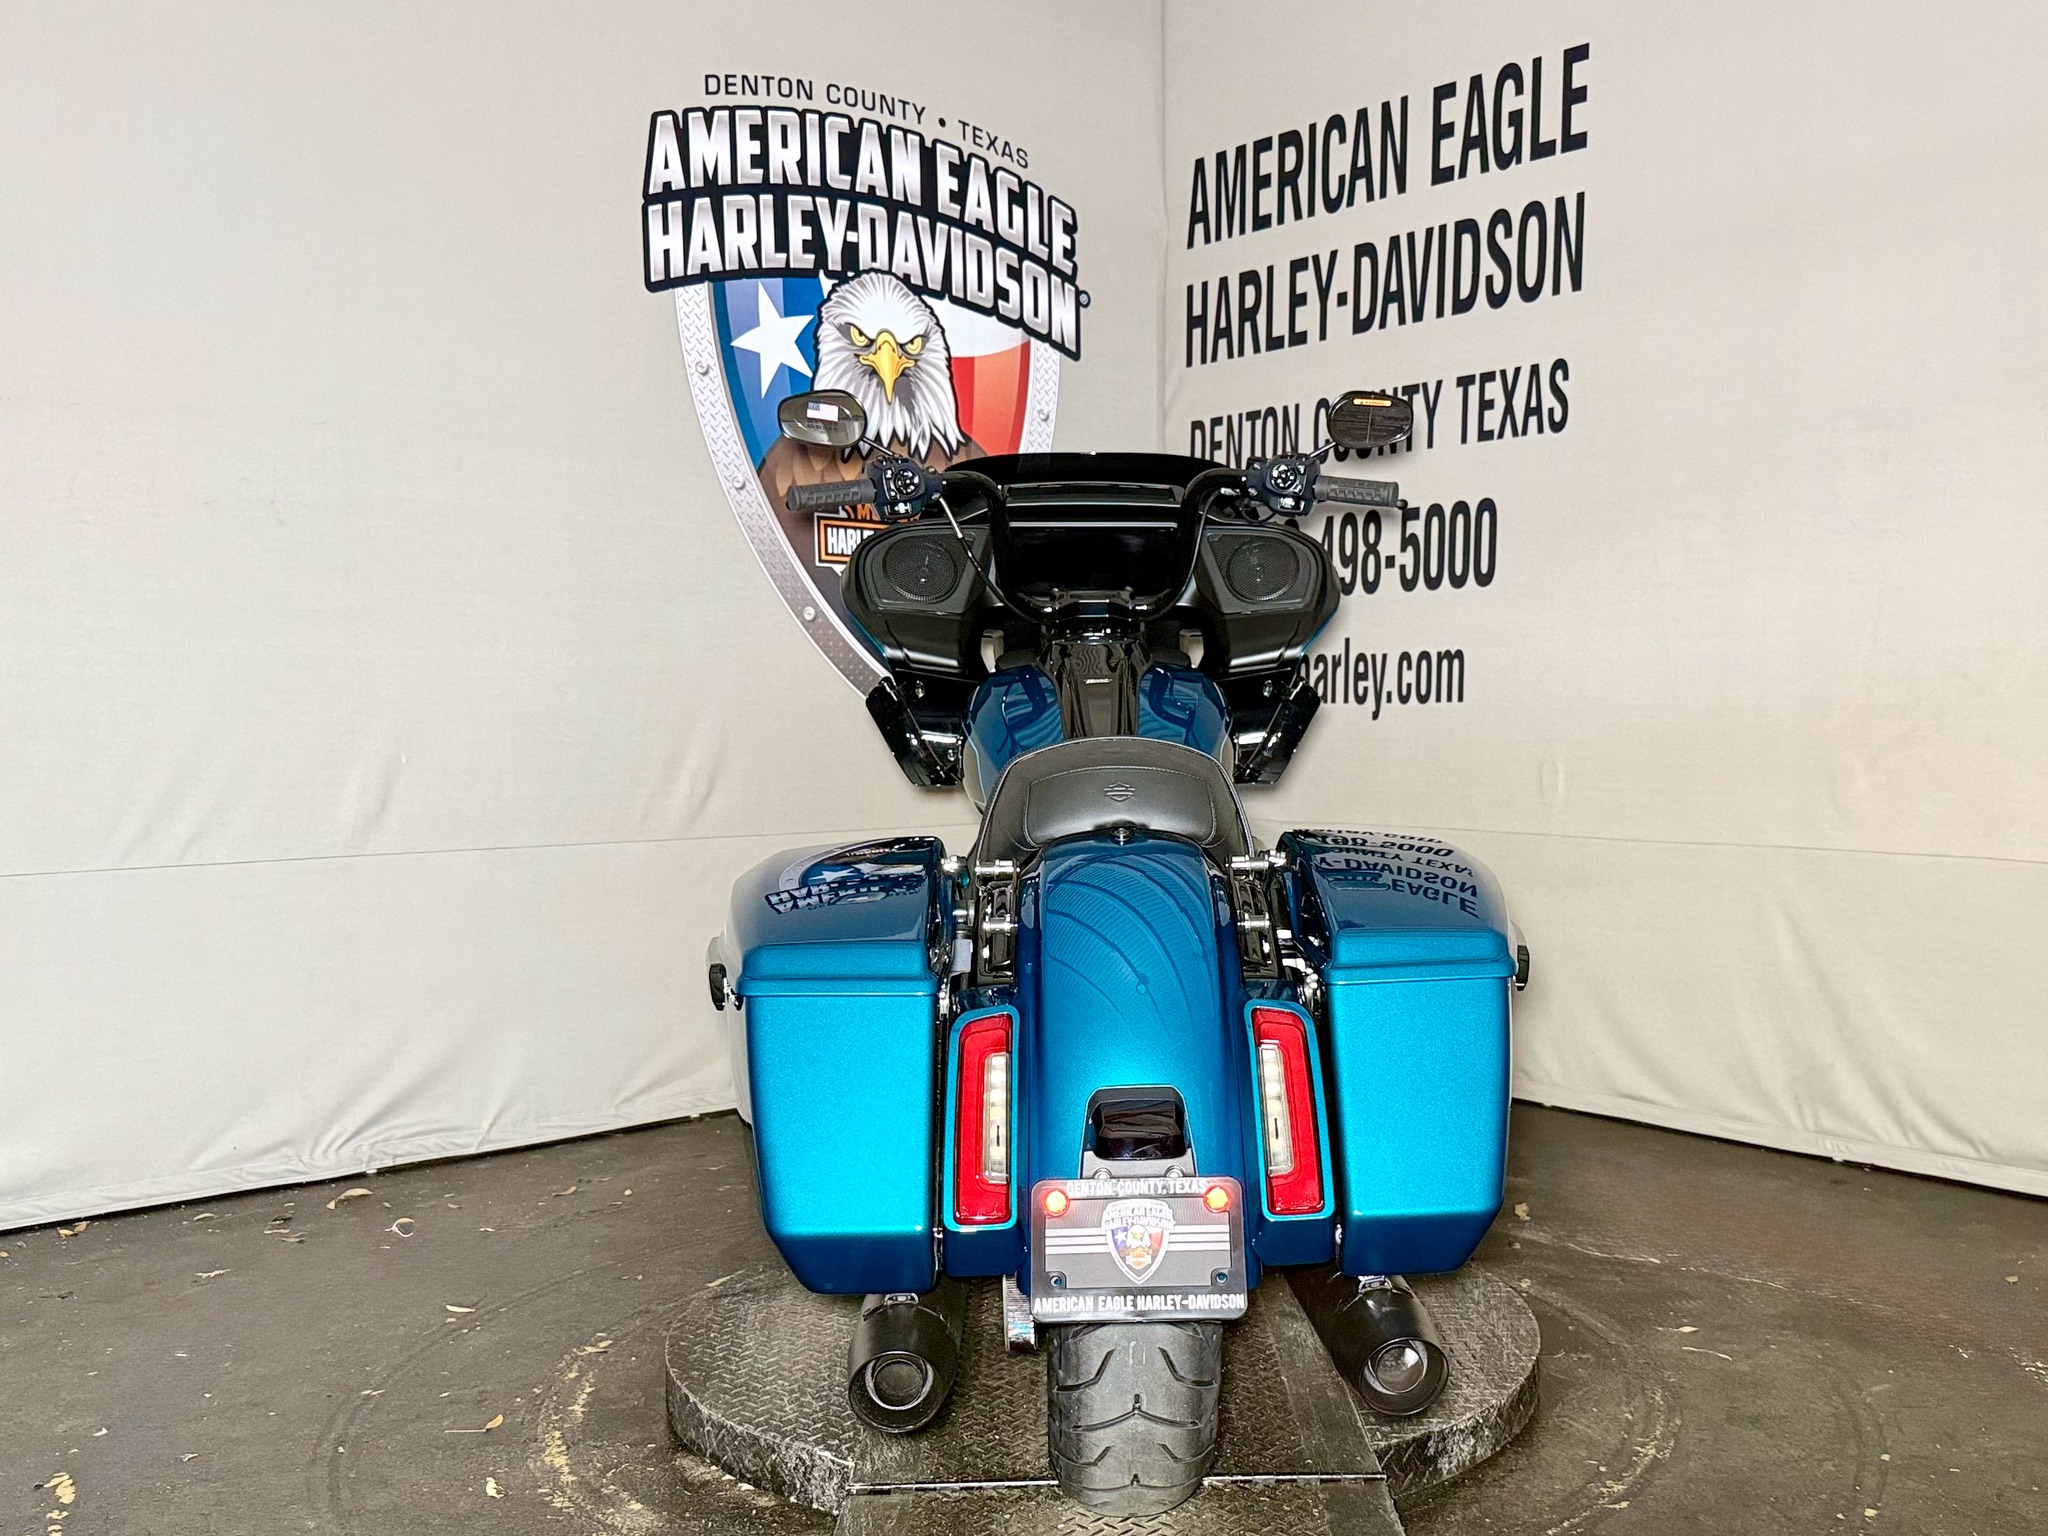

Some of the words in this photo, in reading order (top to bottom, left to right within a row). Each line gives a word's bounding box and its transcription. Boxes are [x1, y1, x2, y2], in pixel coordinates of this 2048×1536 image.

[704, 74, 814, 101] DENTON
[825, 84, 927, 125] COUNTY
[957, 120, 1029, 169] TEXAS
[1186, 95, 1409, 250] AMERICAN
[1431, 42, 1590, 187] EAGLE
[647, 108, 925, 207] AMERICAN
[935, 142, 1076, 272] EAGLE
[647, 194, 1077, 352] HARLEY-DAVIDSON
[1186, 191, 1586, 368] HARLEY-DAVIDSON
[1190, 403, 1300, 470] DENTON
[1456, 358, 1570, 445] TEXAS
[1066, 1180, 1112, 1196] DENTON
[1168, 1179, 1208, 1195] TEXAS
[1034, 1297, 1094, 1314] AMERICAN
[1098, 1295, 1134, 1311] EAGLE
[1136, 1293, 1245, 1311] HARLEY-DAVIDSON
